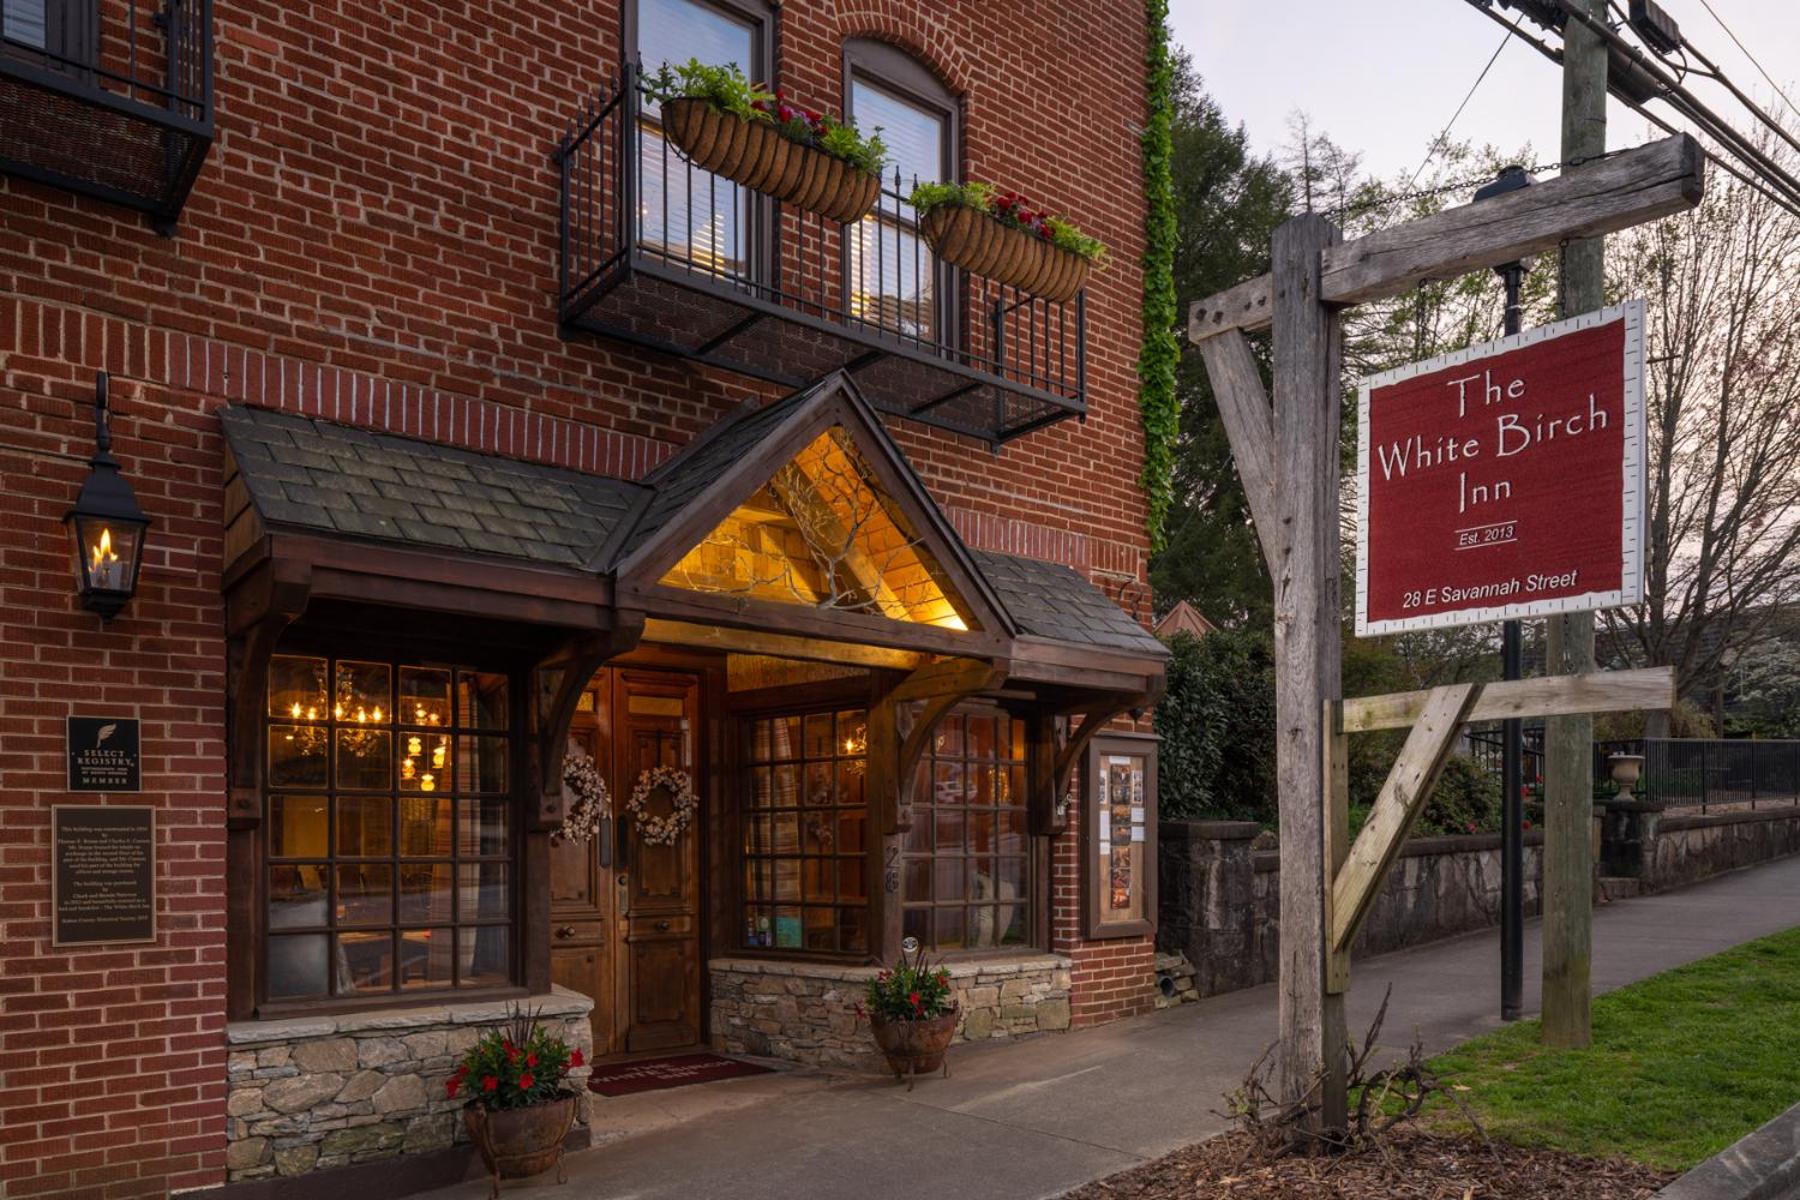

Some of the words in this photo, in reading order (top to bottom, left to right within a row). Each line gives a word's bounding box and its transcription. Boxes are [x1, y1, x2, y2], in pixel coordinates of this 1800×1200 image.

[1447, 369, 1525, 418] The
[1378, 434, 1480, 481] White
[1496, 393, 1608, 458] Birch
[1459, 472, 1512, 513] Inn
[1459, 533, 1481, 546] Est.
[1485, 525, 1515, 542] 2013
[1403, 590, 1421, 608] 28
[1425, 588, 1438, 605] E
[1441, 577, 1520, 602] Savannah
[1525, 569, 1579, 592] Street
[84, 749, 125, 757] SELECT
